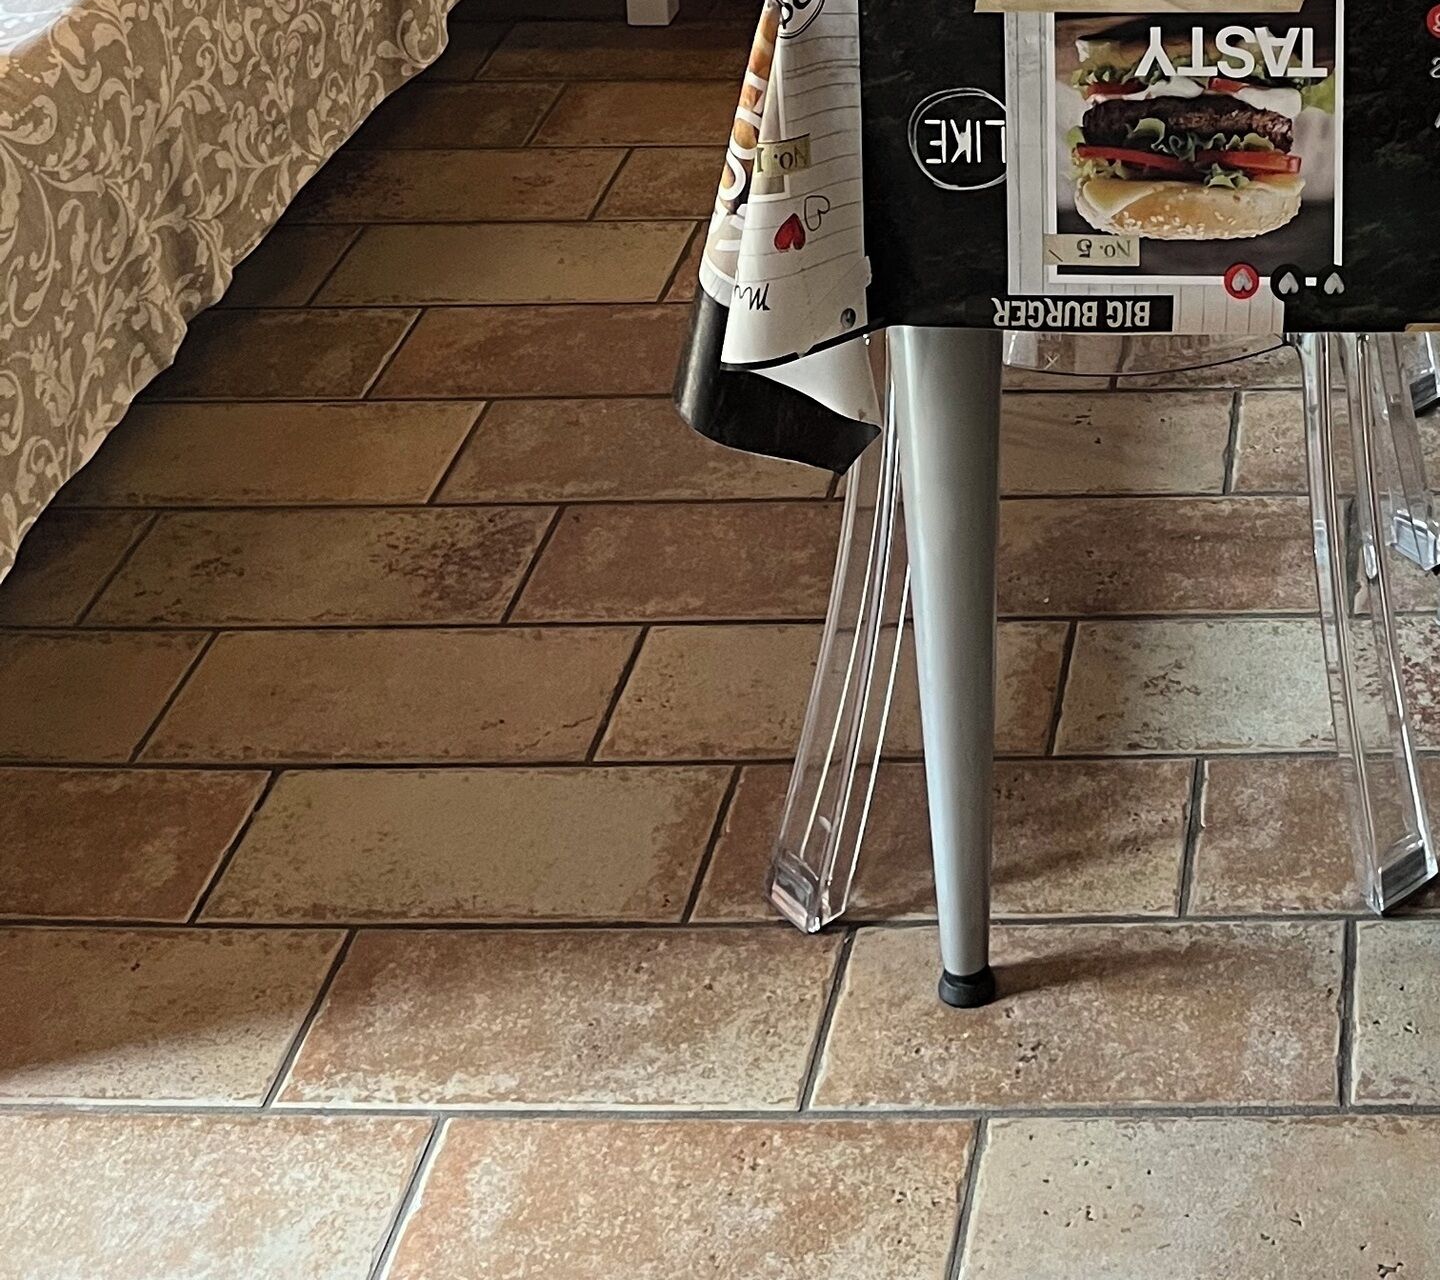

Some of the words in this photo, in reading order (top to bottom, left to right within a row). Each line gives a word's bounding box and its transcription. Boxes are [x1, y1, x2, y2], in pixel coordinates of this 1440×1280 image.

[1135, 26, 1328, 78] TASTY
[924, 118, 1006, 165] LIKE
[1076, 238, 1093, 259] 5
[1098, 240, 1132, 258] No.
[991, 297, 1099, 327] BURGER
[1106, 300, 1151, 327] BIG
